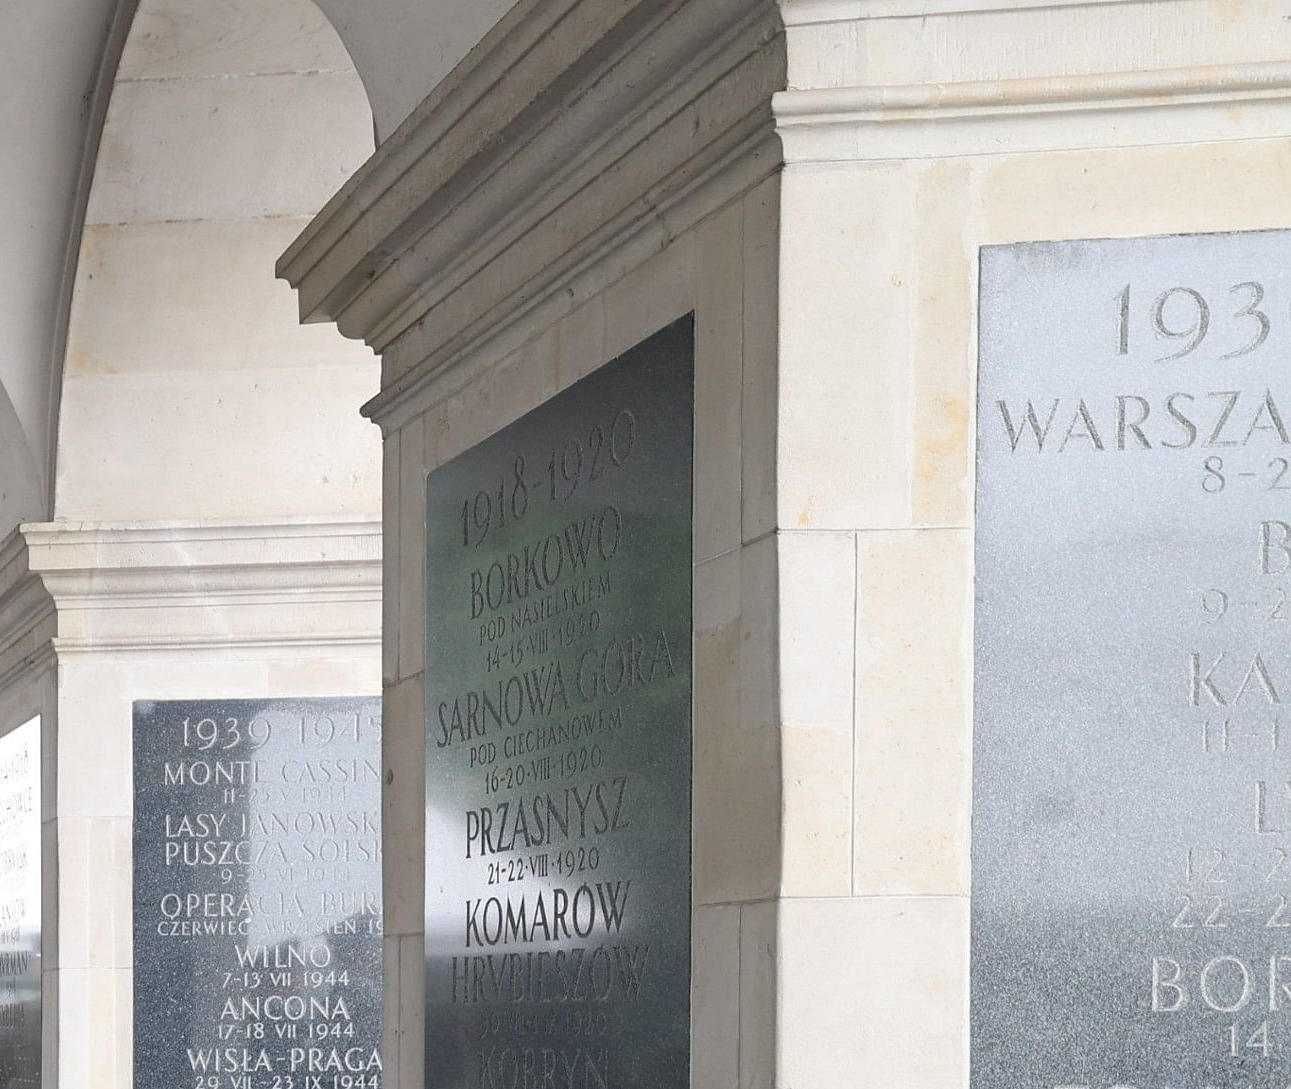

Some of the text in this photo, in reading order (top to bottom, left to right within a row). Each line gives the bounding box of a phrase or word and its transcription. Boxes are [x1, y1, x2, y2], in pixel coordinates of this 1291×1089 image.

[460, 409, 636, 548] 1918-1920
[470, 506, 621, 620] BORKOWO
[481, 616, 505, 646] POD
[436, 660, 570, 748] SARNOWA
[470, 742, 496, 768] POD
[165, 761, 268, 786] MONTE
[166, 813, 227, 837] LASY
[466, 775, 629, 859] PRZASNYSZ
[166, 840, 287, 865] PUSZCZA
[157, 920, 251, 936] CZERWIEC
[235, 945, 330, 968] WILNO
[222, 971, 349, 988] 7-13 VII 1944
[221, 996, 351, 1021] ANCONA
[219, 1023, 354, 1040] 17-18 VII 1944
[230, 1076, 252, 1089] VII
[306, 1076, 321, 1089] IX
